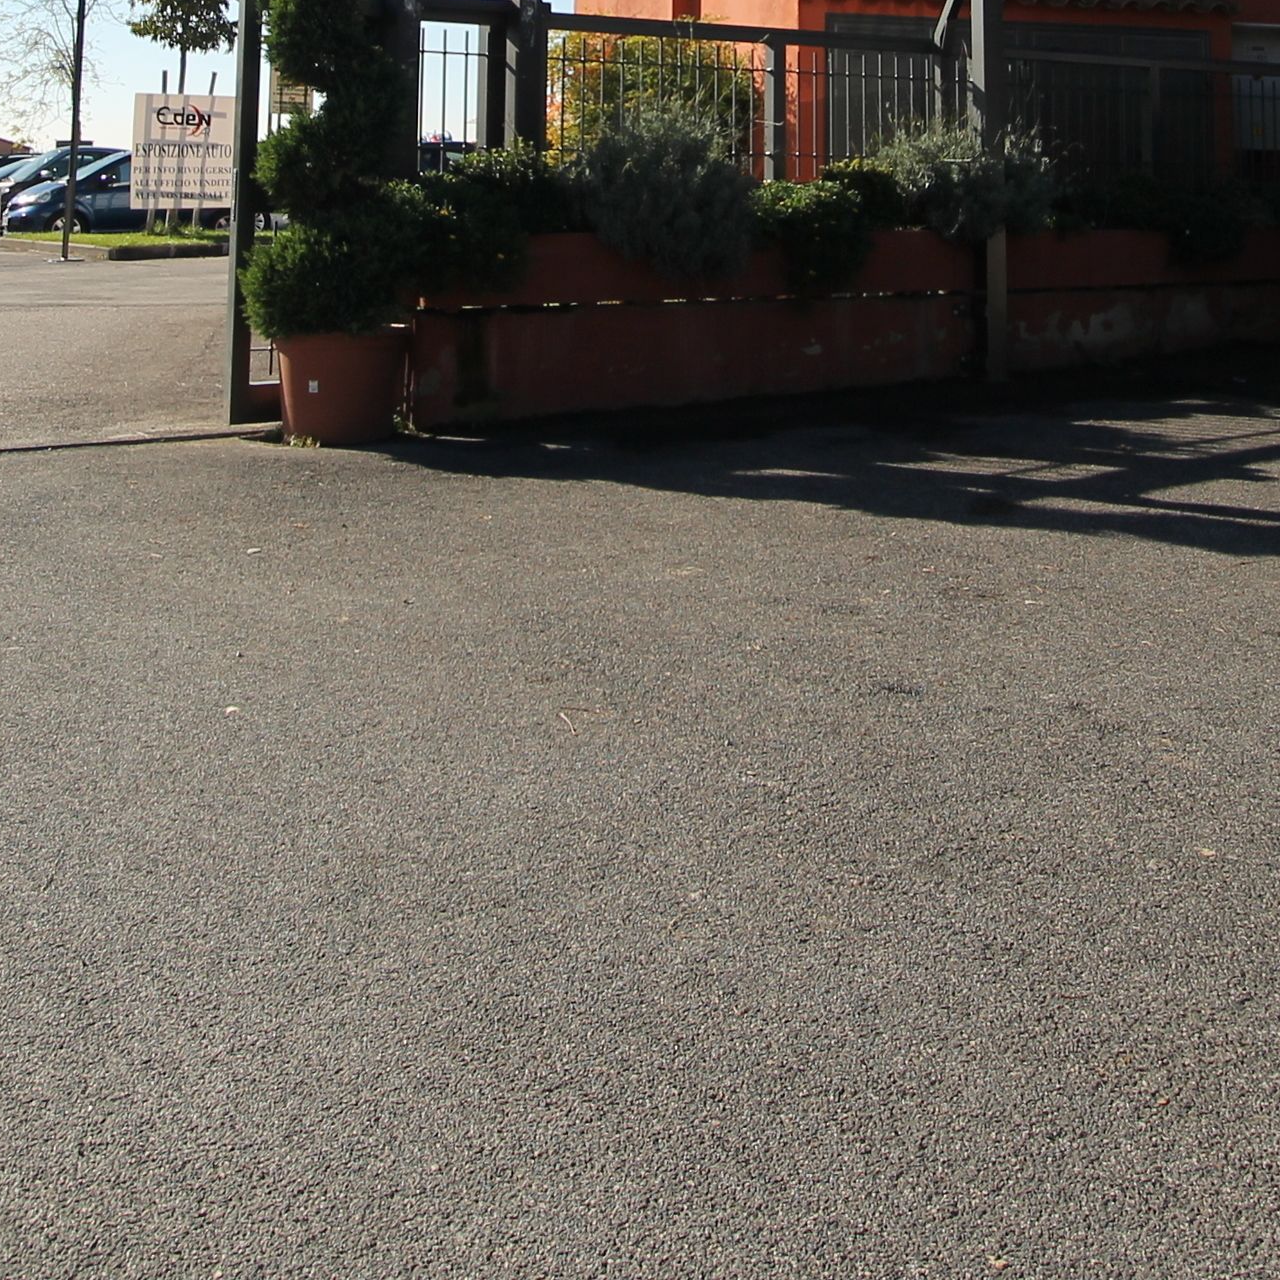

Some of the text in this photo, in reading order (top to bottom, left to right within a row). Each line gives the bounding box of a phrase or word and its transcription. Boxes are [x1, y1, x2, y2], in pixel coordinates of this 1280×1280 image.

[135, 143, 232, 159] ESPOSIZIONE AUTO
[133, 166, 232, 174] PER INFO RIVOLGERSI
[193, 179, 231, 187] VENDITE
